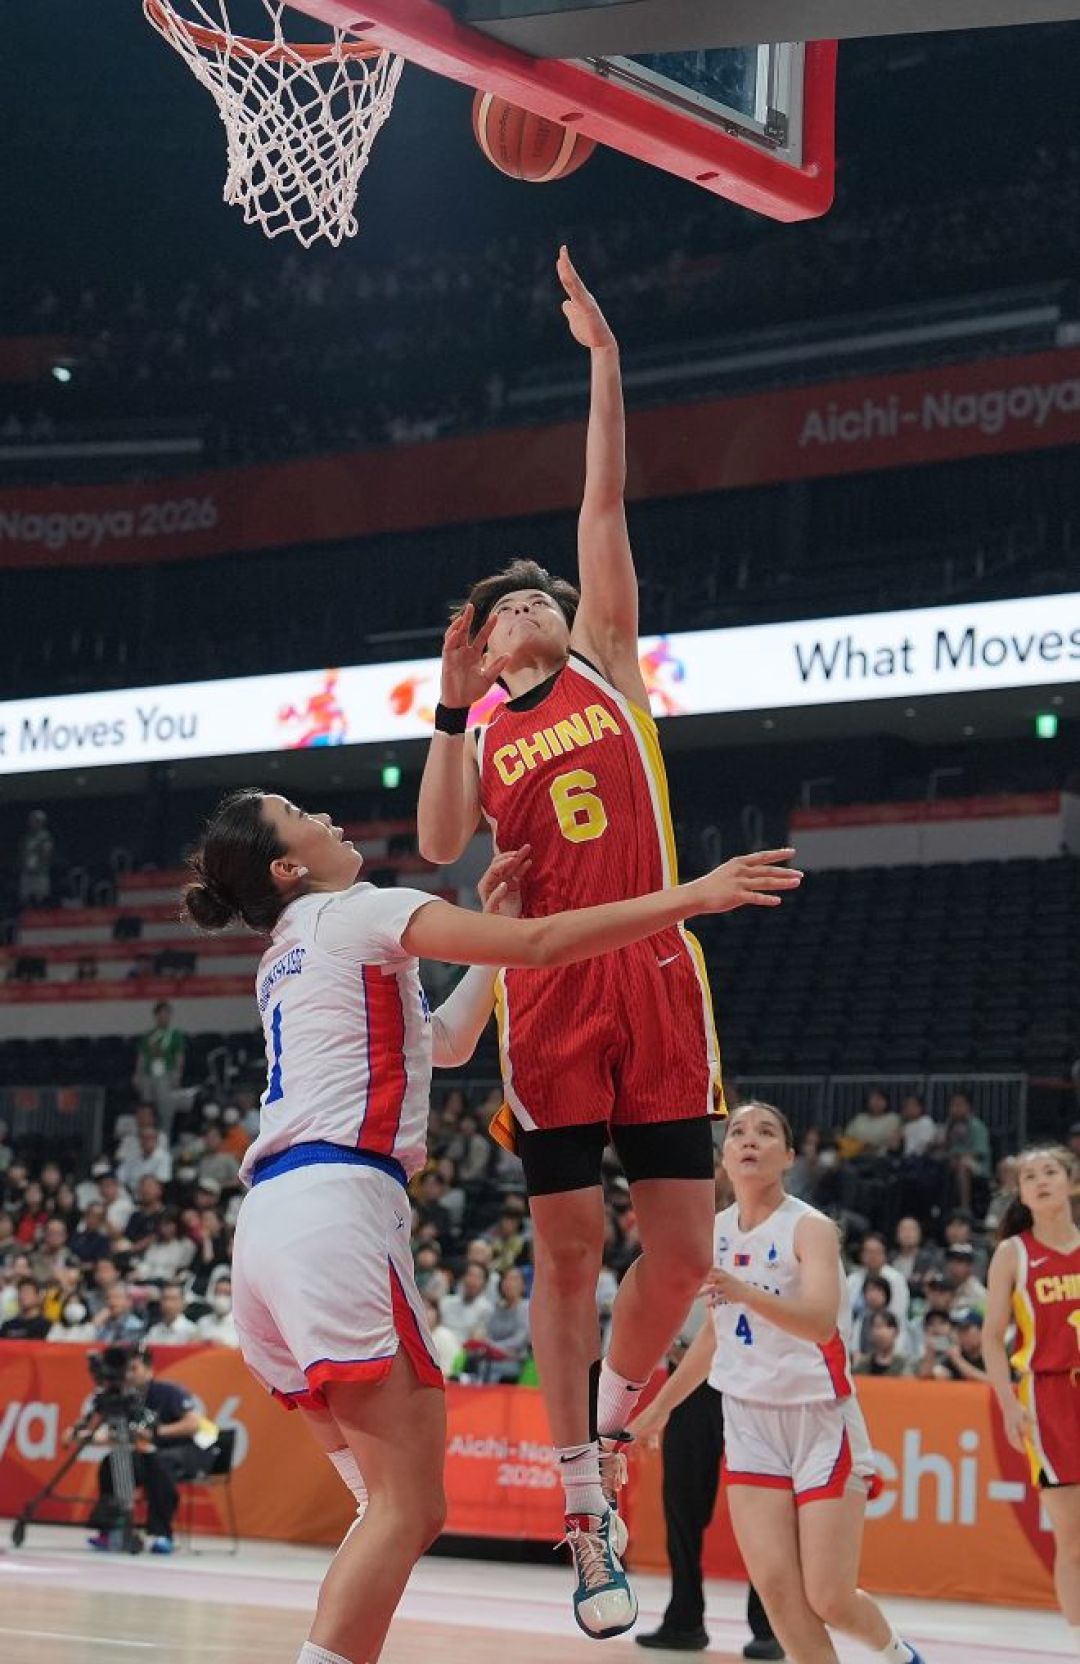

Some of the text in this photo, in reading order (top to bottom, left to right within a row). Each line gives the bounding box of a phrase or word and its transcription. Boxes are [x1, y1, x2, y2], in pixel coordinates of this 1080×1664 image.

[798, 379, 1080, 447] Aichi-Nagoya
[0, 497, 217, 549] Nagoya 2026
[794, 628, 1080, 682] What Moves
[20, 716, 125, 753] Moves
[136, 706, 198, 742] You
[493, 703, 622, 786] CHINA
[550, 768, 608, 844] 6
[265, 1001, 284, 1105] 1
[735, 1313, 753, 1345] 4
[498, 1464, 558, 1489] 2026
